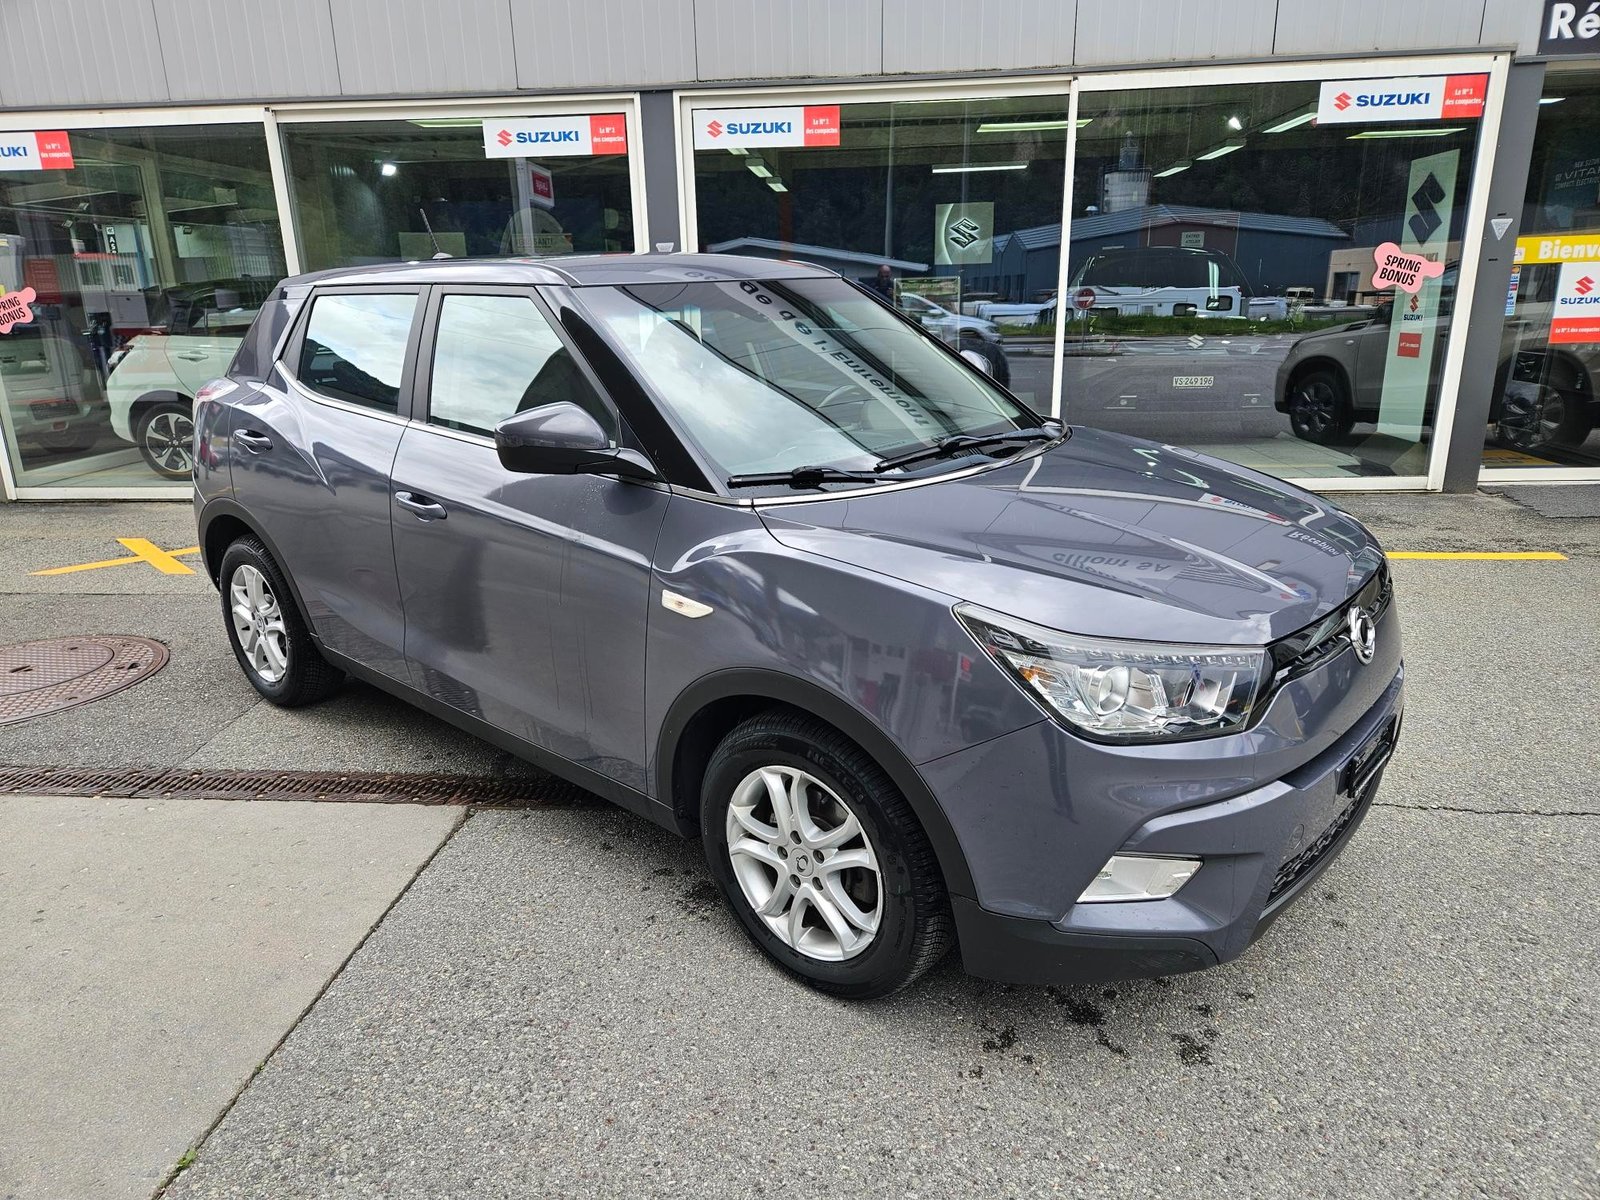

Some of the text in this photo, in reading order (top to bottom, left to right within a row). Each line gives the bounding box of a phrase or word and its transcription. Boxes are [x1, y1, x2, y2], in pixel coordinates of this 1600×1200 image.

[1548, 2, 1600, 39] Ré
[1356, 93, 1430, 107] SUZUKI
[727, 122, 791, 134] SUZUKI
[516, 130, 580, 143] SUZUKI
[0, 146, 28, 157] UKI
[1538, 239, 1600, 260] Bienv
[1385, 255, 1422, 273] SPRING
[1379, 267, 1416, 286] BONUS
